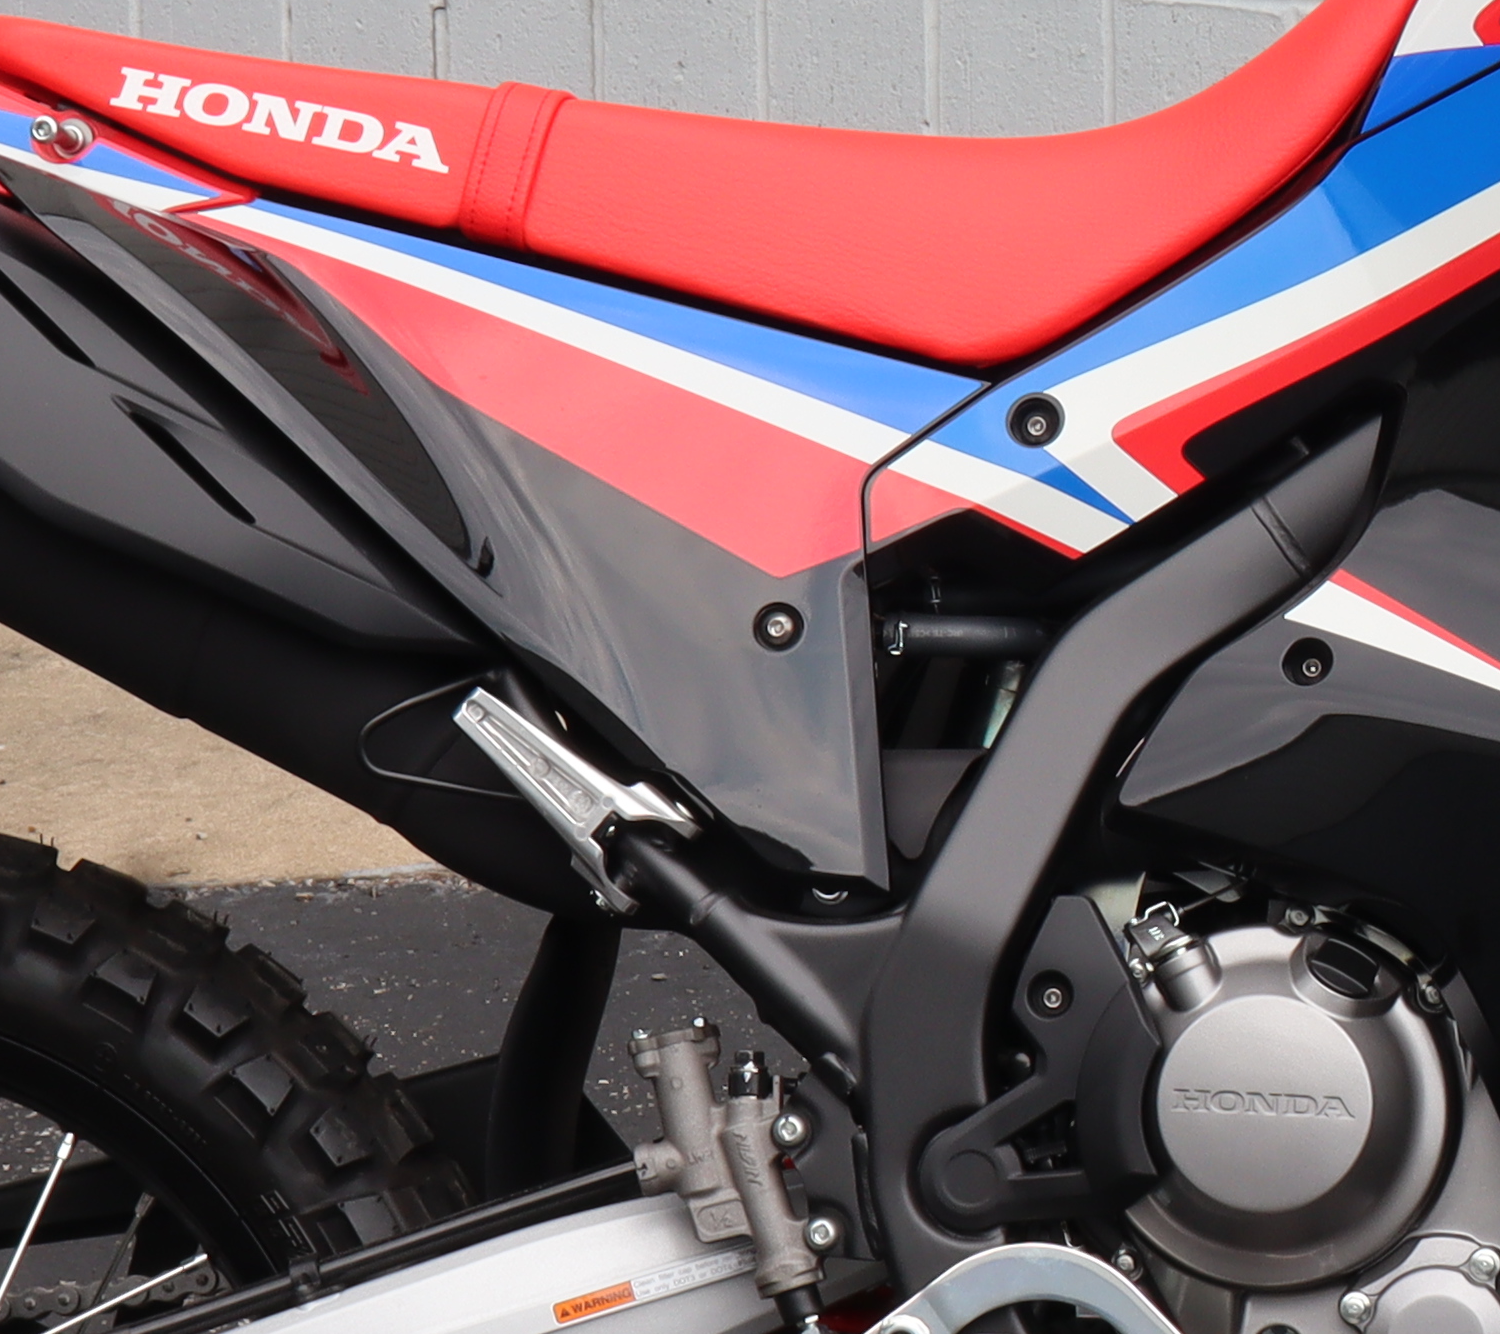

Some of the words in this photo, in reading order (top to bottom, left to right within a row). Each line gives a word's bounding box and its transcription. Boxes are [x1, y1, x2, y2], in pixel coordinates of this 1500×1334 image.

[109, 66, 449, 174] HONDA
[1172, 1088, 1357, 1120] HONDA
[673, 1274, 697, 1287] DOT3
[571, 1286, 632, 1315] WARNING
